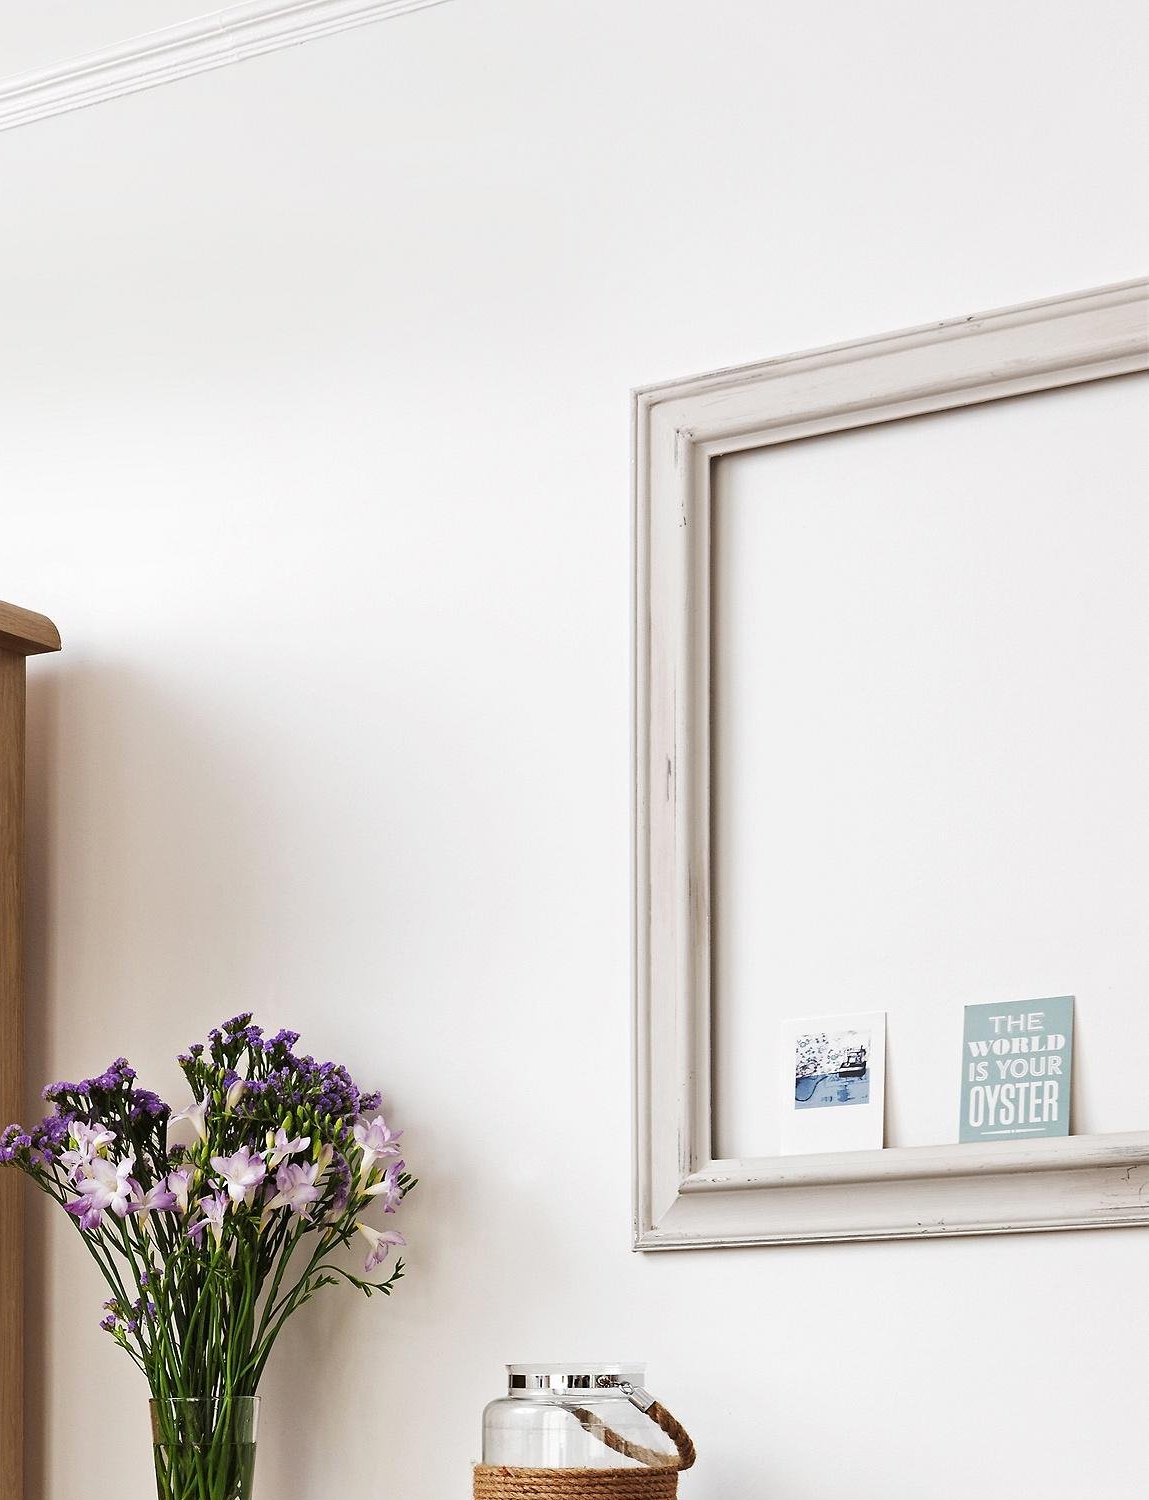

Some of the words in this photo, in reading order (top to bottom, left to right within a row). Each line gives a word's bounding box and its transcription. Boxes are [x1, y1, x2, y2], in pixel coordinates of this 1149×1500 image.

[988, 1012, 1045, 1034] THE
[967, 1034, 1066, 1058] WORLD
[969, 1061, 989, 1082] IS
[995, 1055, 1063, 1080] YOUR
[969, 1080, 1059, 1128] OYSTER
